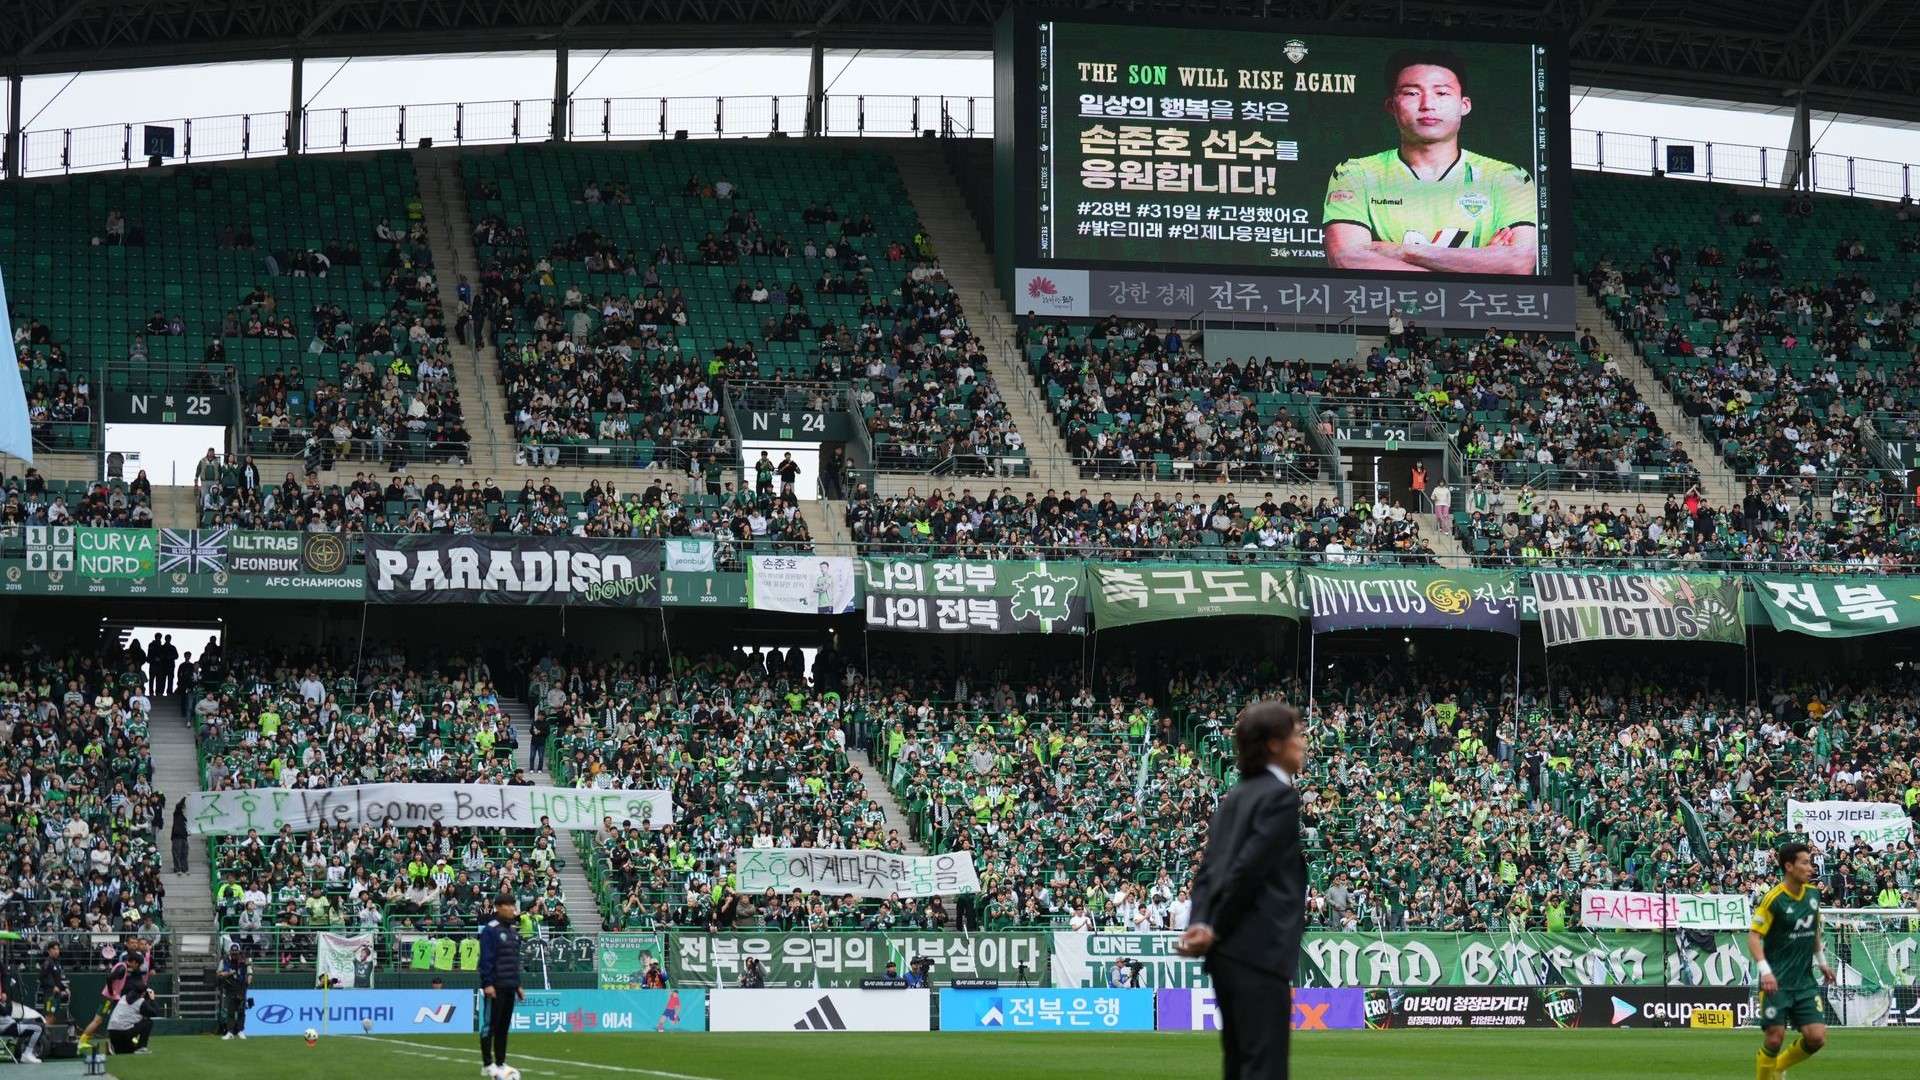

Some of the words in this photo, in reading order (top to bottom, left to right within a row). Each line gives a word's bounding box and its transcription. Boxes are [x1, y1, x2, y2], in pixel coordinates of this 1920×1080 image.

[1078, 63, 1118, 82] THE
[1128, 64, 1167, 86] SON
[1178, 67, 1228, 88] WILL
[1238, 70, 1284, 90] RISE
[1294, 72, 1356, 94] AGAIN
[1079, 94, 1152, 117] 일상의
[1160, 97, 1234, 121] 행복을
[1242, 100, 1290, 122] 찾은
[1080, 124, 1191, 156] 손준호
[1202, 129, 1300, 161] 선수를
[1080, 159, 1277, 196] 응원합니다!
[1078, 202, 1130, 218] #28번
[1136, 204, 1201, 220] #319일
[1207, 206, 1308, 224] #고생했어요
[1078, 222, 1162, 239] #밝은미래
[1168, 224, 1326, 244] #언제나응원합니다
[1292, 250, 1326, 258] YEARS
[1108, 281, 1150, 304] 강한
[1156, 283, 1194, 307] 경제
[1208, 282, 1269, 312] 전주,
[1278, 284, 1330, 314] 다시
[1344, 285, 1446, 318] 전라도의
[1458, 290, 1549, 320] 수도로!
[132, 395, 148, 414] N
[186, 396, 212, 415] 25
[752, 412, 768, 430] N
[802, 414, 826, 432] 24
[1336, 428, 1350, 440] N
[1384, 430, 1406, 442] 23
[1888, 442, 1901, 460] N
[80, 532, 152, 552] CURVA
[232, 534, 298, 551] ULTRAS
[80, 555, 140, 575] NORD
[230, 558, 298, 571] JEONBUK
[376, 547, 632, 592] PARADISO
[762, 558, 798, 570] 손준호
[266, 578, 290, 587] AFC
[292, 578, 363, 588] CHAMPIONS
[865, 560, 924, 592] 나의
[933, 563, 996, 592] 전부
[48, 584, 64, 592] 2017
[1030, 584, 1056, 607] 12
[1308, 574, 1426, 617] INVICTUS
[1472, 581, 1520, 620] 전북
[1534, 574, 1647, 602] ULTRAS
[866, 596, 926, 628] 나의
[936, 599, 998, 630] 전북
[1764, 581, 1899, 632] 전북
[1544, 605, 1700, 641] INVICTUS
[1440, 710, 1450, 719] 28
[195, 791, 289, 835] 준호!
[302, 790, 444, 824] Welcome
[454, 788, 516, 820] Back
[530, 791, 621, 826] HOME
[420, 950, 426, 960] 7
[442, 946, 448, 956] 7
[466, 946, 472, 958] 7
[679, 936, 771, 973] 전북은
[782, 936, 874, 973] 우리의
[886, 936, 1040, 974] 자부심이다
[1093, 937, 1141, 954] ONE
[1308, 938, 1442, 987] MAD
[546, 998, 560, 1007] FC
[1008, 996, 1120, 1026] 전북은행
[1420, 998, 1450, 1012] 맛이
[1454, 997, 1529, 1012] 청정라거다!
[300, 1006, 394, 1022] HYUNDAI
[602, 1012, 632, 1028] 에서
[1442, 1016, 1462, 1024] 100%
[1505, 1016, 1525, 1024] 100%
[1698, 1013, 1726, 1026] 레모나
